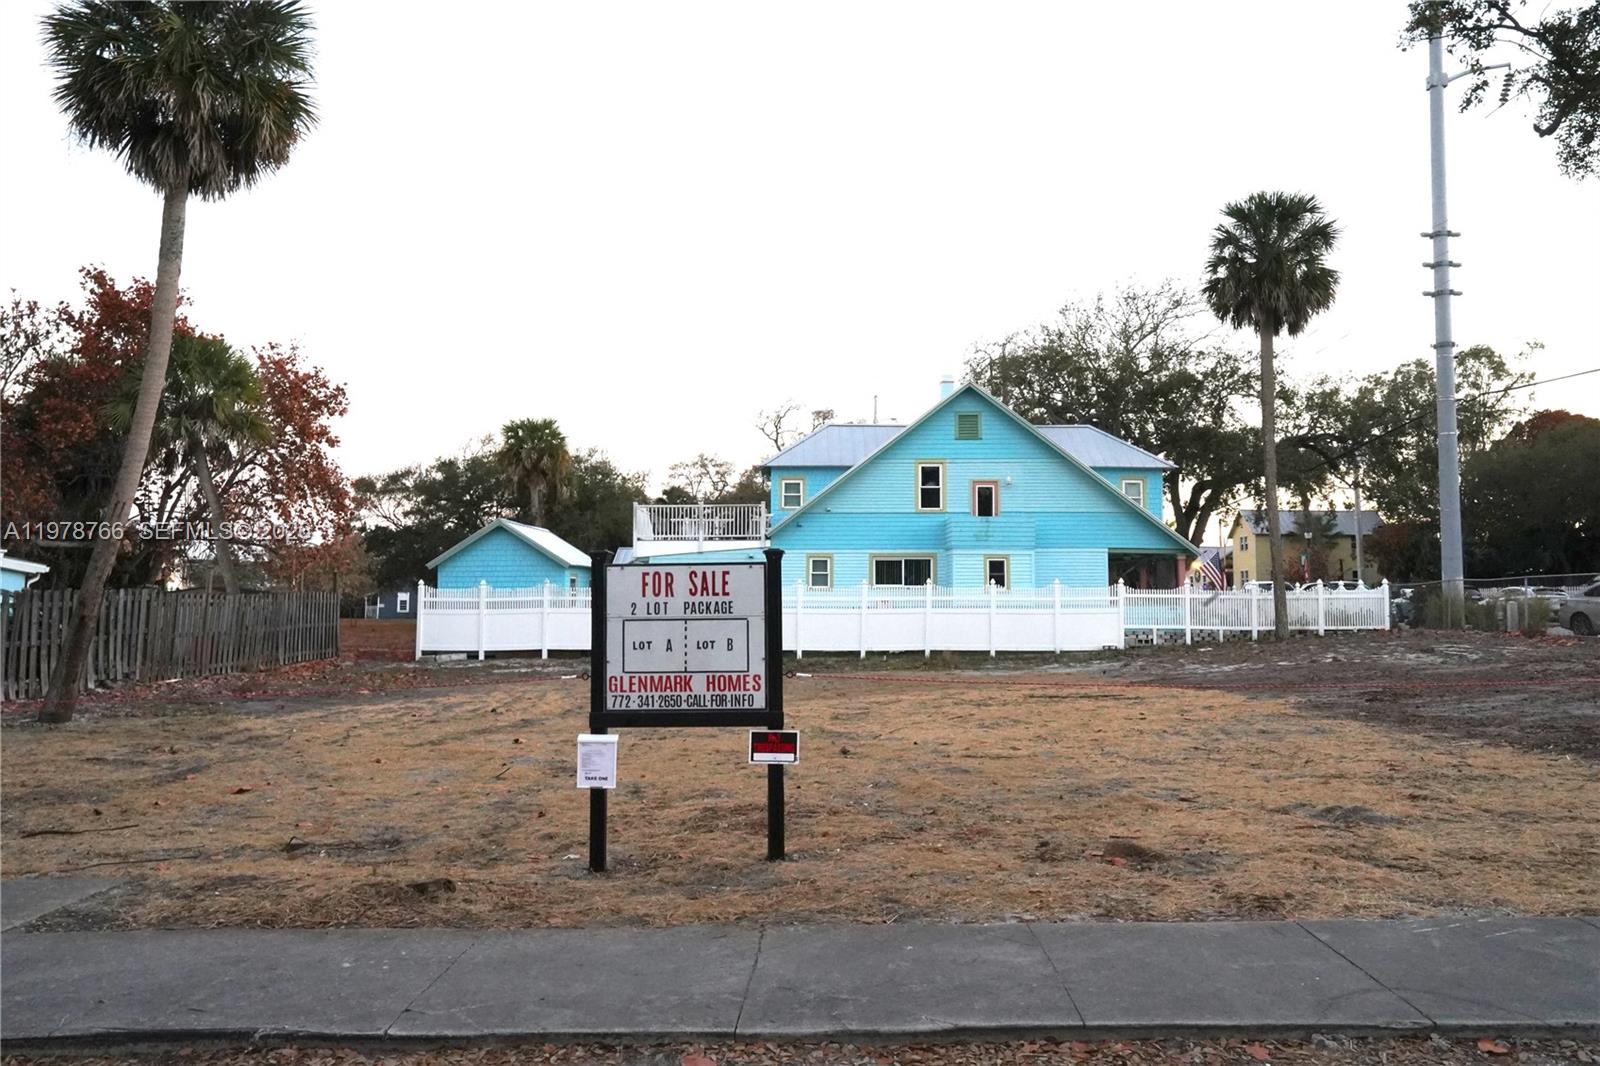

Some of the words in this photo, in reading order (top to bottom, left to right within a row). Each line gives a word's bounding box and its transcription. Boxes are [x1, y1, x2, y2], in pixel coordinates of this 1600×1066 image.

[641, 571, 674, 598] FOR
[689, 570, 730, 597] SALE
[631, 602, 637, 615] 2
[646, 601, 669, 615] LOT
[684, 600, 734, 615] PACKAGE
[632, 640, 653, 650] LOT
[666, 638, 673, 652] A
[696, 640, 716, 650] LOT
[727, 638, 734, 651] B
[608, 675, 693, 693] GLENMARK
[706, 674, 762, 692] HOMES
